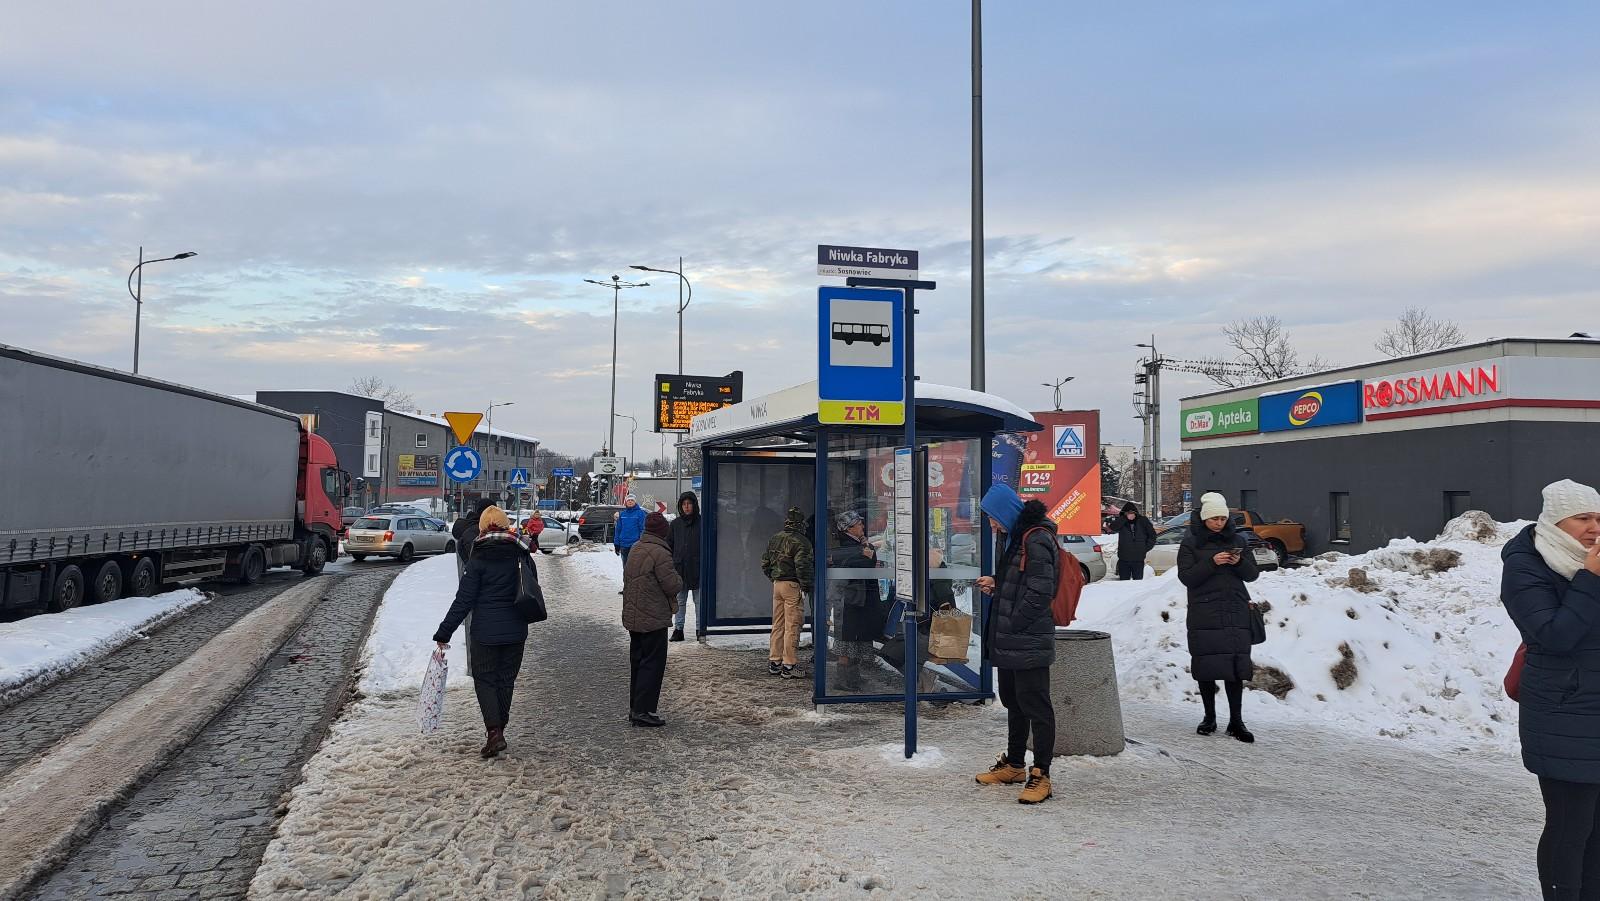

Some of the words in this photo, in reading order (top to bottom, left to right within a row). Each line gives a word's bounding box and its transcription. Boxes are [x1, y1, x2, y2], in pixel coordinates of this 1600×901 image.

[829, 249, 863, 262] Niwka
[866, 252, 908, 266] Fabryka
[838, 268, 872, 276] Sosnowiec
[1364, 364, 1498, 408] ROSSMANN
[844, 404, 880, 420] ZTM
[1294, 402, 1318, 414] PEPCO
[1218, 408, 1252, 429] Apteka
[1052, 490, 1080, 520] PROMOCJE
